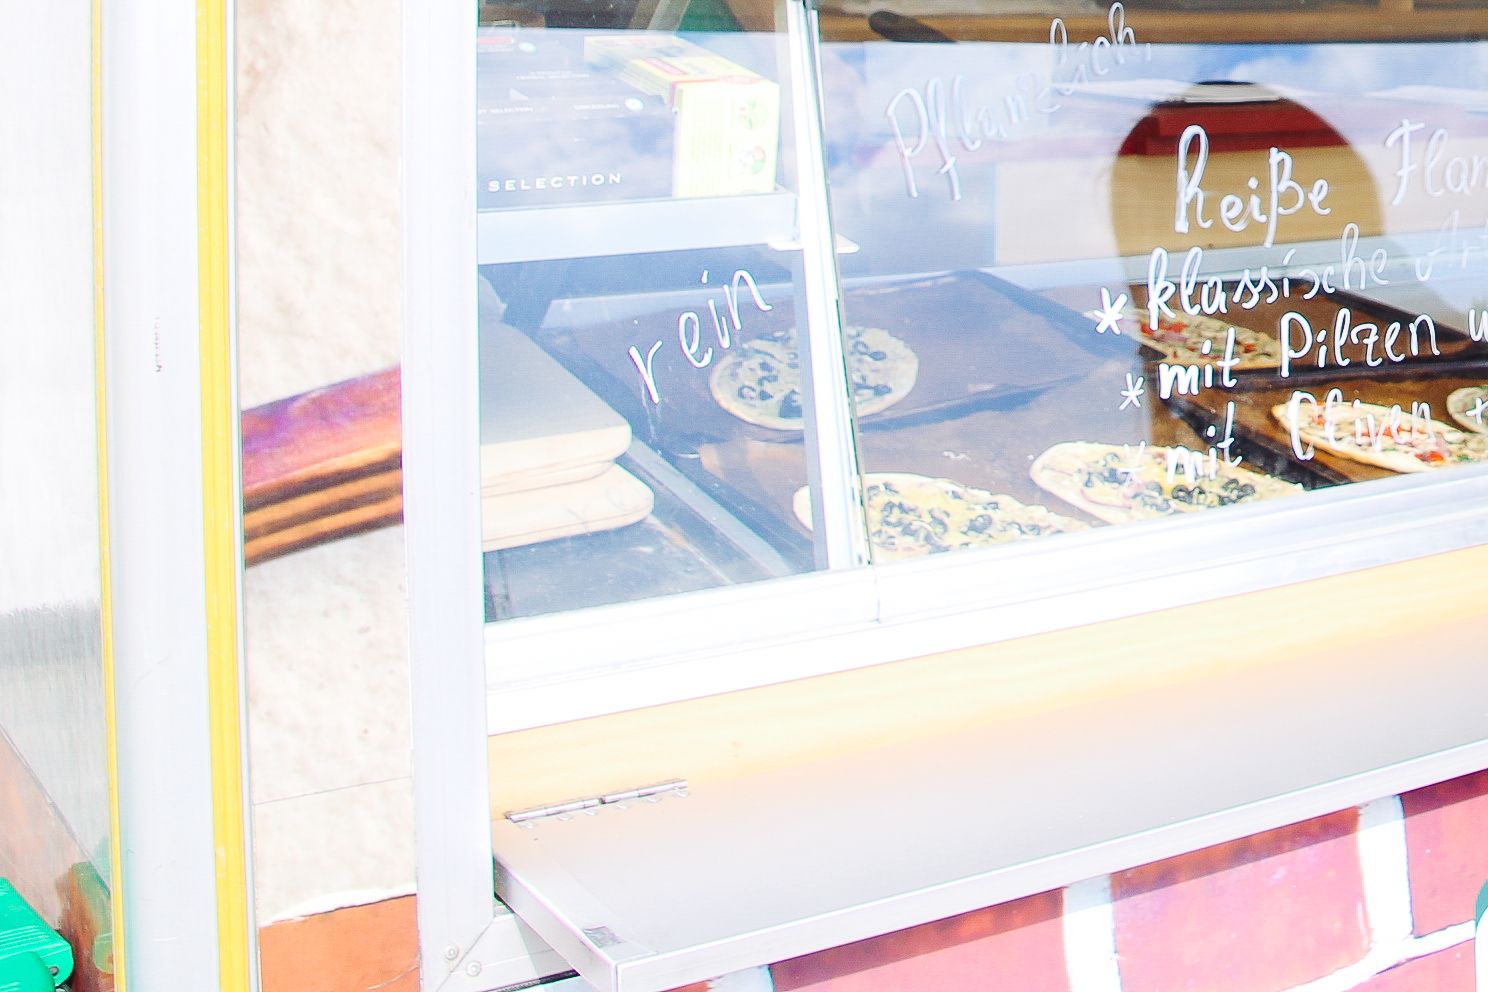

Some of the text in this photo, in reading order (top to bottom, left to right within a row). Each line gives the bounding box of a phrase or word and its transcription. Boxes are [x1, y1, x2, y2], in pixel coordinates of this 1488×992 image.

[487, 172, 623, 194] SELECTION
[1175, 124, 1332, 247] heiße
[1147, 222, 1389, 332] klassische
[628, 268, 773, 405] rein
[1158, 327, 1243, 401] mit
[1279, 309, 1441, 378] Pilzen
[1165, 401, 1244, 485] mit
